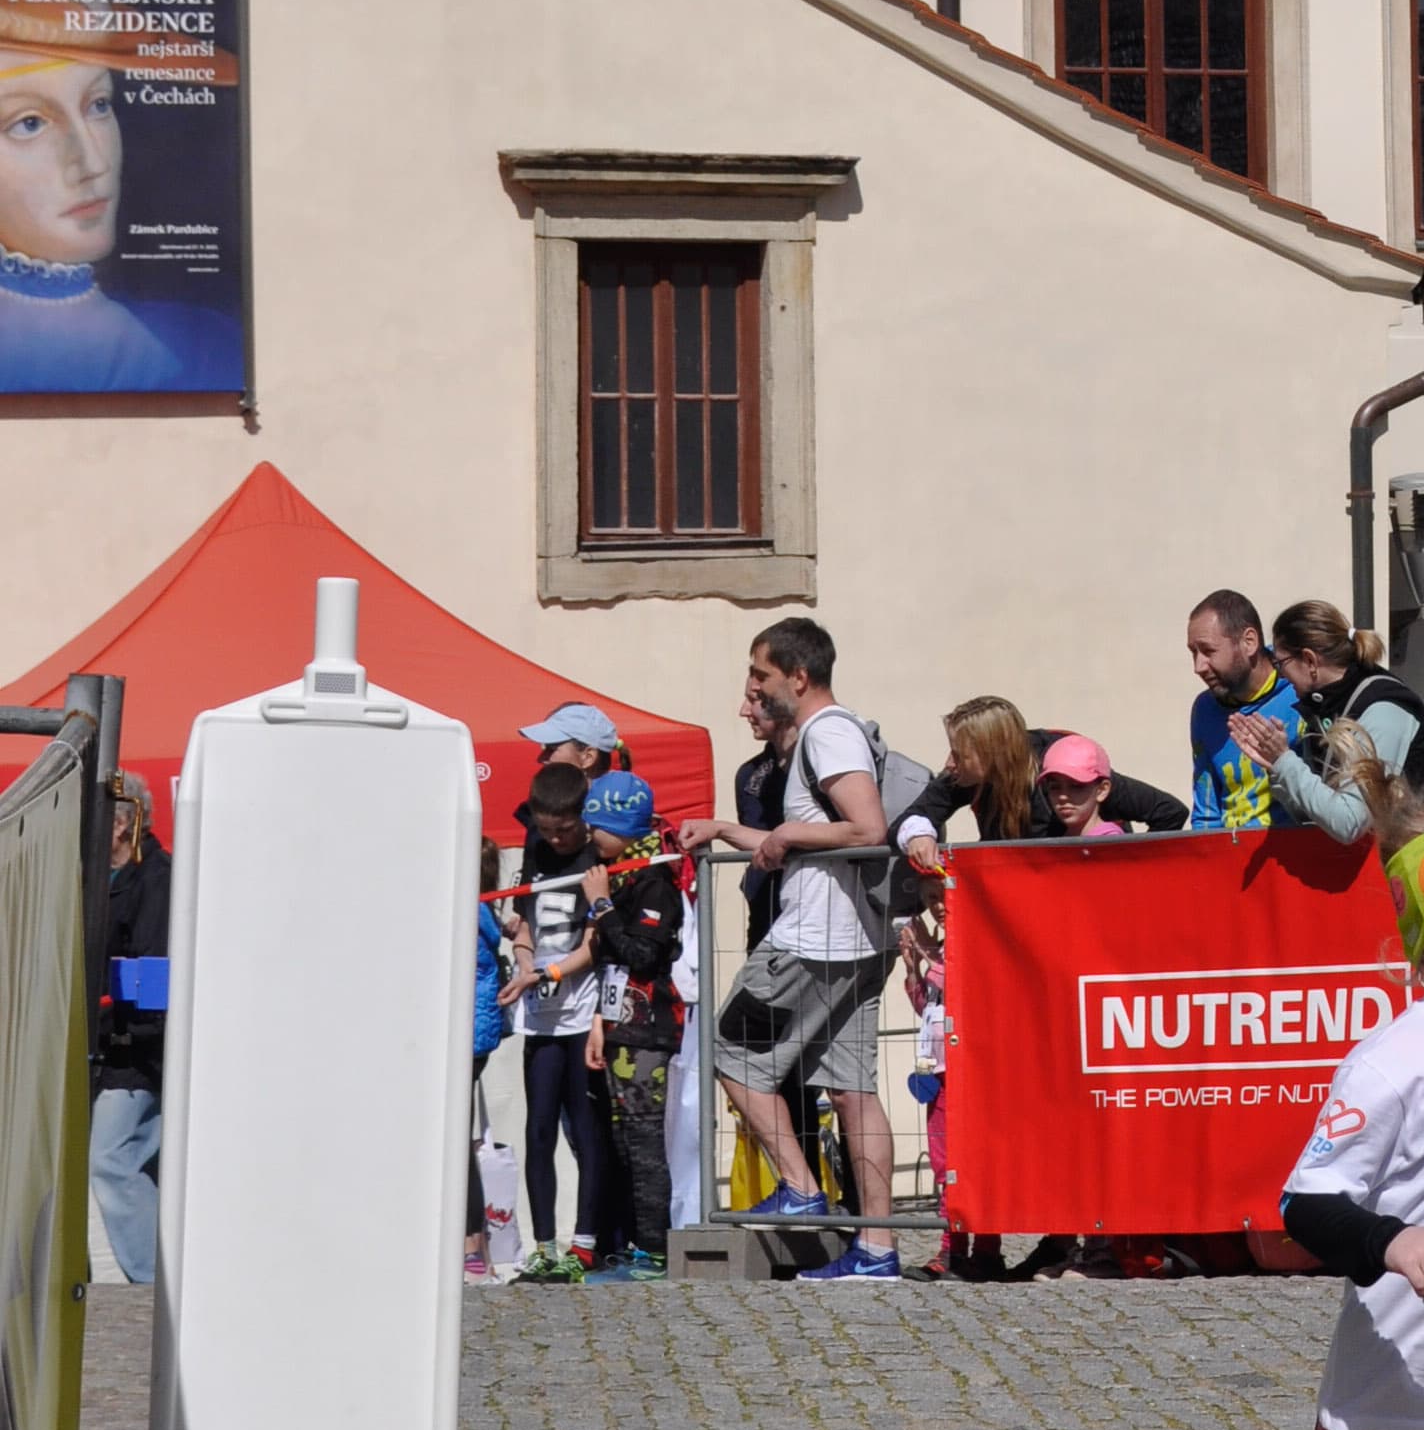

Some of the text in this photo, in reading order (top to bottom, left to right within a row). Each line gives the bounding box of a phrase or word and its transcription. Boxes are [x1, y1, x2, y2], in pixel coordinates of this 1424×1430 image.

[64, 10, 215, 33] REZIDENCE
[137, 39, 215, 60] nejstarší
[125, 67, 216, 82] renesance
[124, 84, 216, 105] v Čechách
[1102, 986, 1393, 1050] NUTREND
[1090, 1089, 1137, 1108] THE
[1145, 1086, 1232, 1107] POWER
[1240, 1085, 1272, 1105] OF
